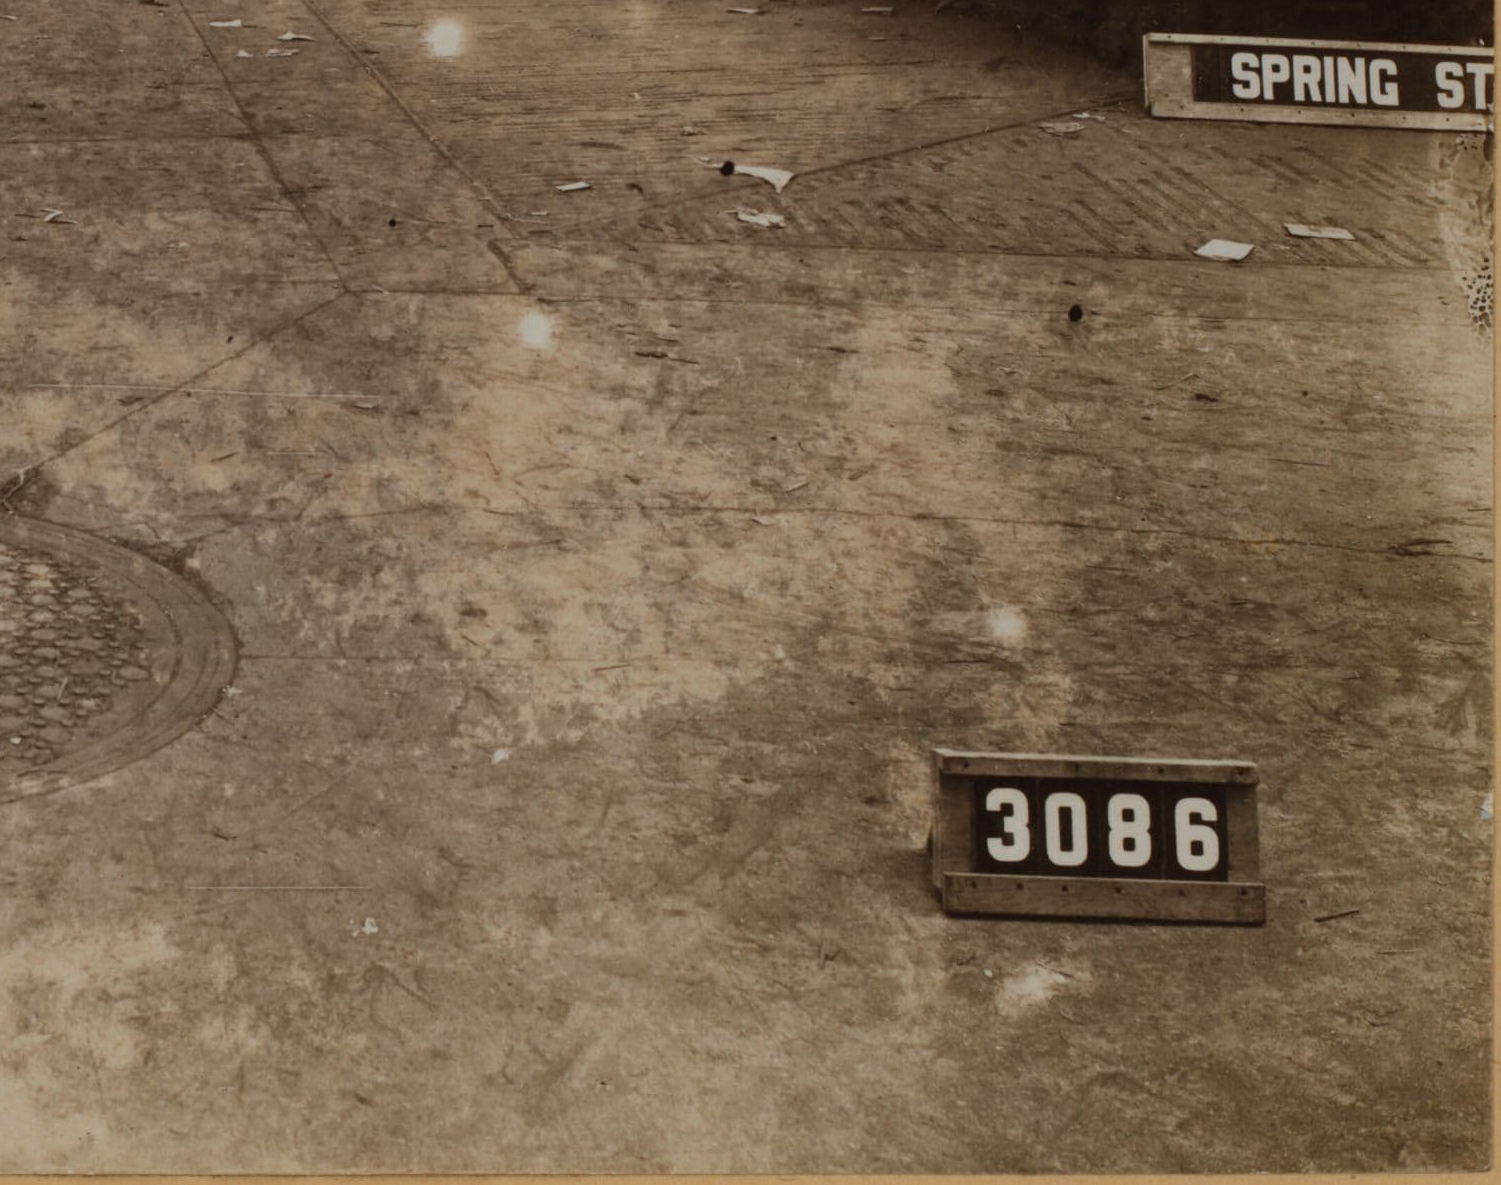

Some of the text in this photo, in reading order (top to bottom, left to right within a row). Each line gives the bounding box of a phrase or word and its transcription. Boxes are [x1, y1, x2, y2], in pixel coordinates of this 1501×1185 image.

[1231, 52, 1495, 110] SPRING ST
[985, 787, 1220, 872] 3086
